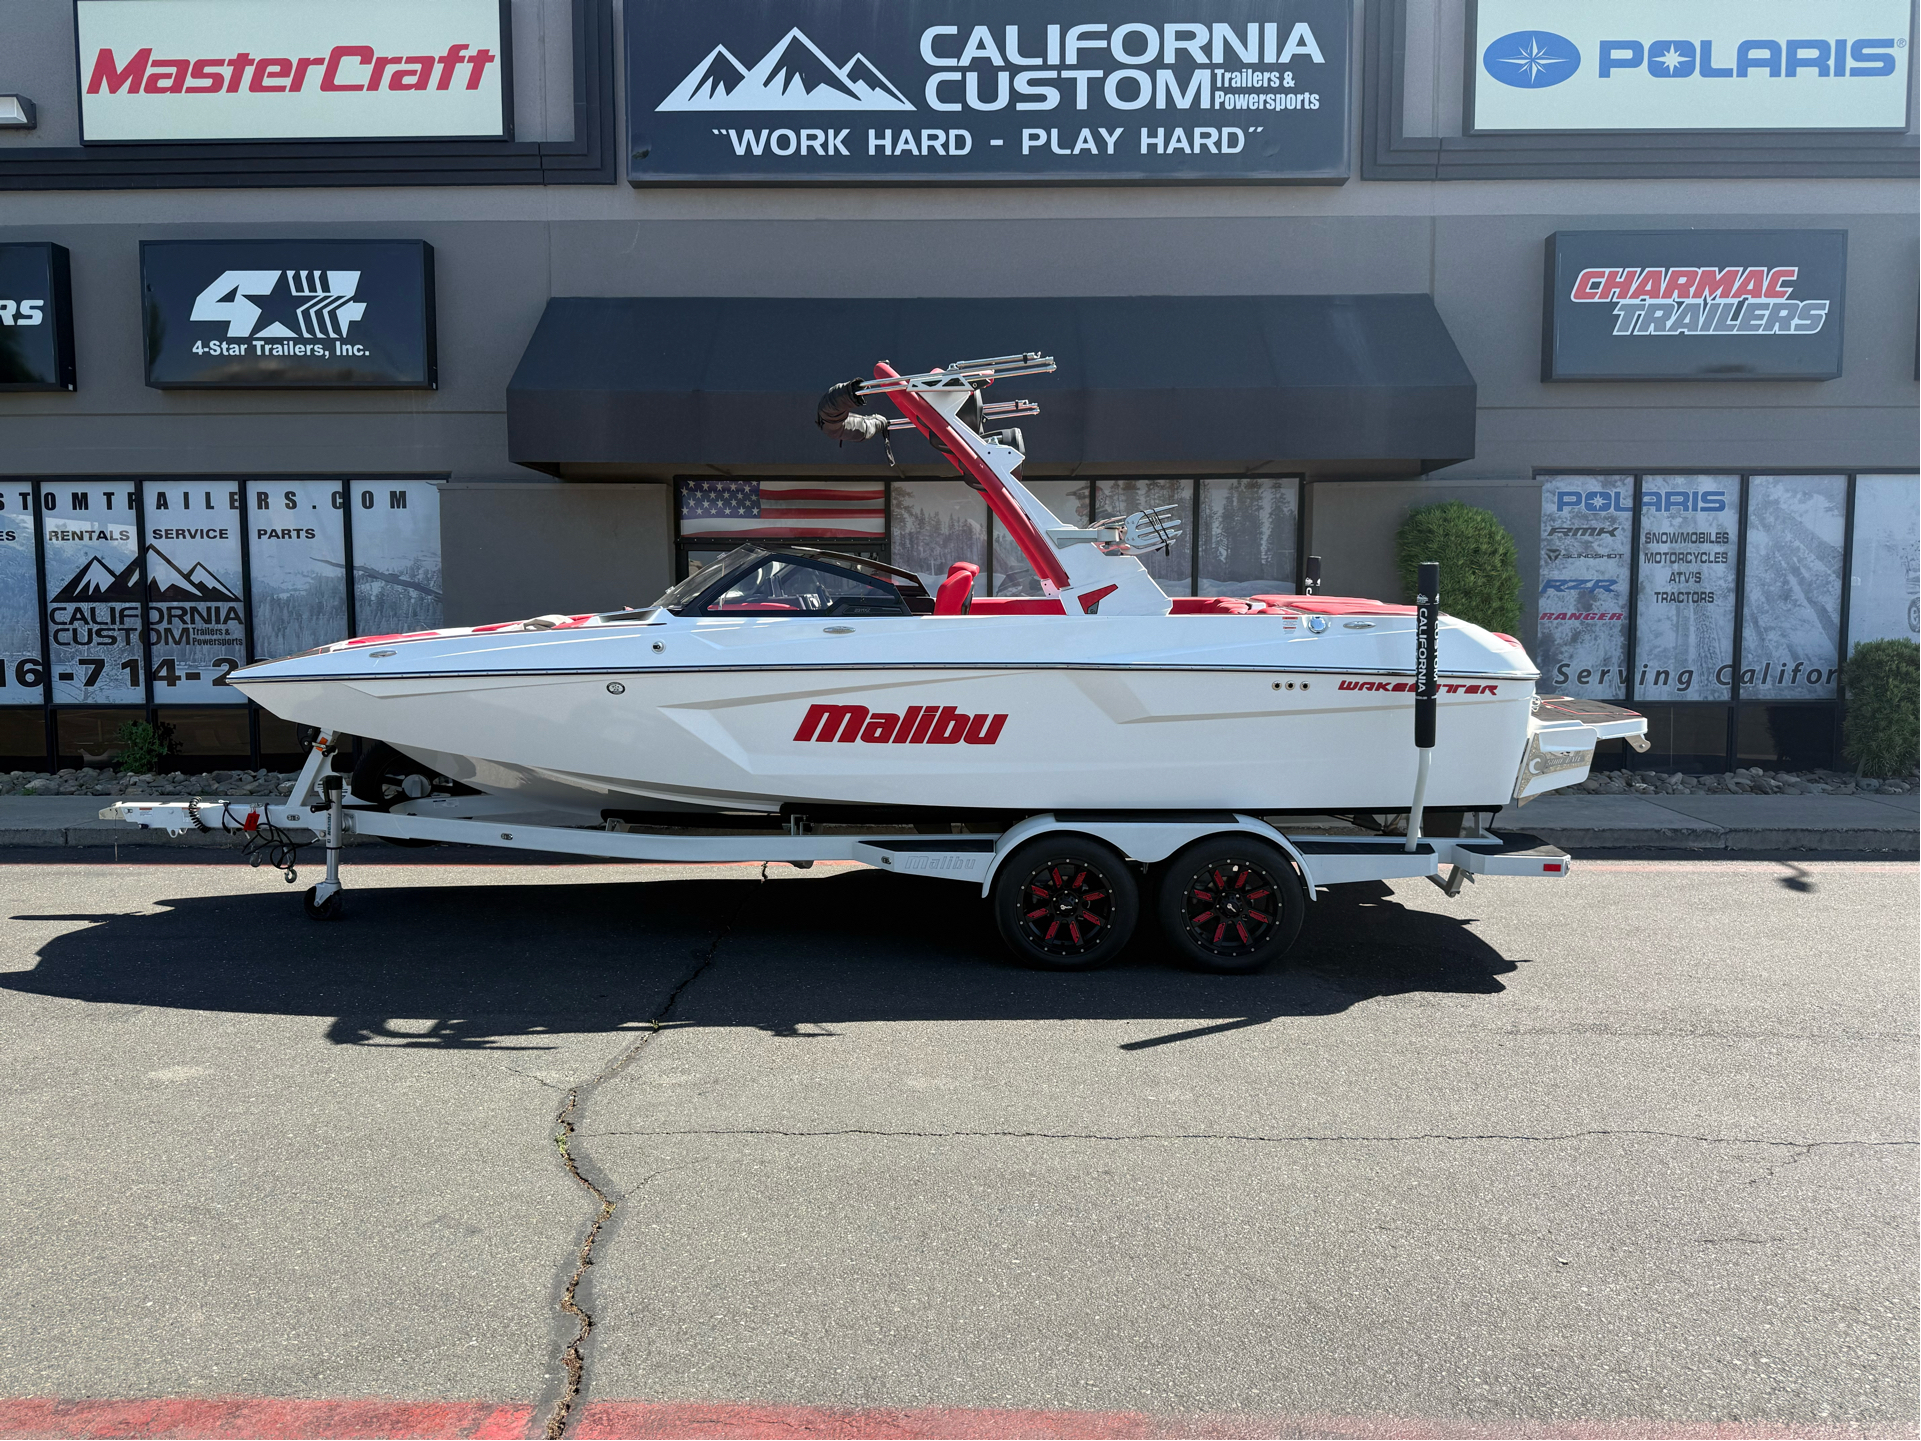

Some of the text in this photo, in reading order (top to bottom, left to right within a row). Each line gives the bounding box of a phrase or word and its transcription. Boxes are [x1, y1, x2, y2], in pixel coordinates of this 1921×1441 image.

[920, 22, 1326, 67] CALIFORNIA
[86, 44, 496, 95] MasterCraft
[1214, 68, 1296, 88] Trailers &
[926, 69, 1211, 112] CUSTOM
[1214, 91, 1320, 112] Powersports
[868, 128, 973, 155] HARD
[1021, 127, 1124, 154] PLAY
[1570, 267, 1798, 302] CHARMAC
[1612, 300, 1830, 335] TRAILERS
[192, 340, 370, 359] 4-Star Trailers, Inc.
[1556, 490, 1727, 513] POLARIS
[48, 530, 131, 541] RENTALS
[152, 528, 229, 540] SERVICE
[257, 528, 316, 540] PARTS
[1546, 526, 1620, 537] RMK
[1644, 532, 1729, 544] SNOWMOBILES
[1643, 552, 1728, 564] MOTORCYCLES
[1539, 578, 1619, 594] RZR
[1668, 571, 1702, 584] ATV'S
[1654, 592, 1715, 604] TRACTORS
[49, 606, 244, 626] CALIFORNIA
[1539, 612, 1624, 621] RANGER
[53, 627, 190, 646] CUSTOM
[192, 627, 231, 637] Trailers &
[192, 637, 243, 647] Powersports
[1417, 607, 1428, 693] CALIFORNIA
[1553, 663, 1693, 692] Serving
[793, 704, 1009, 745] Malibu
[904, 855, 976, 870] Malibu
